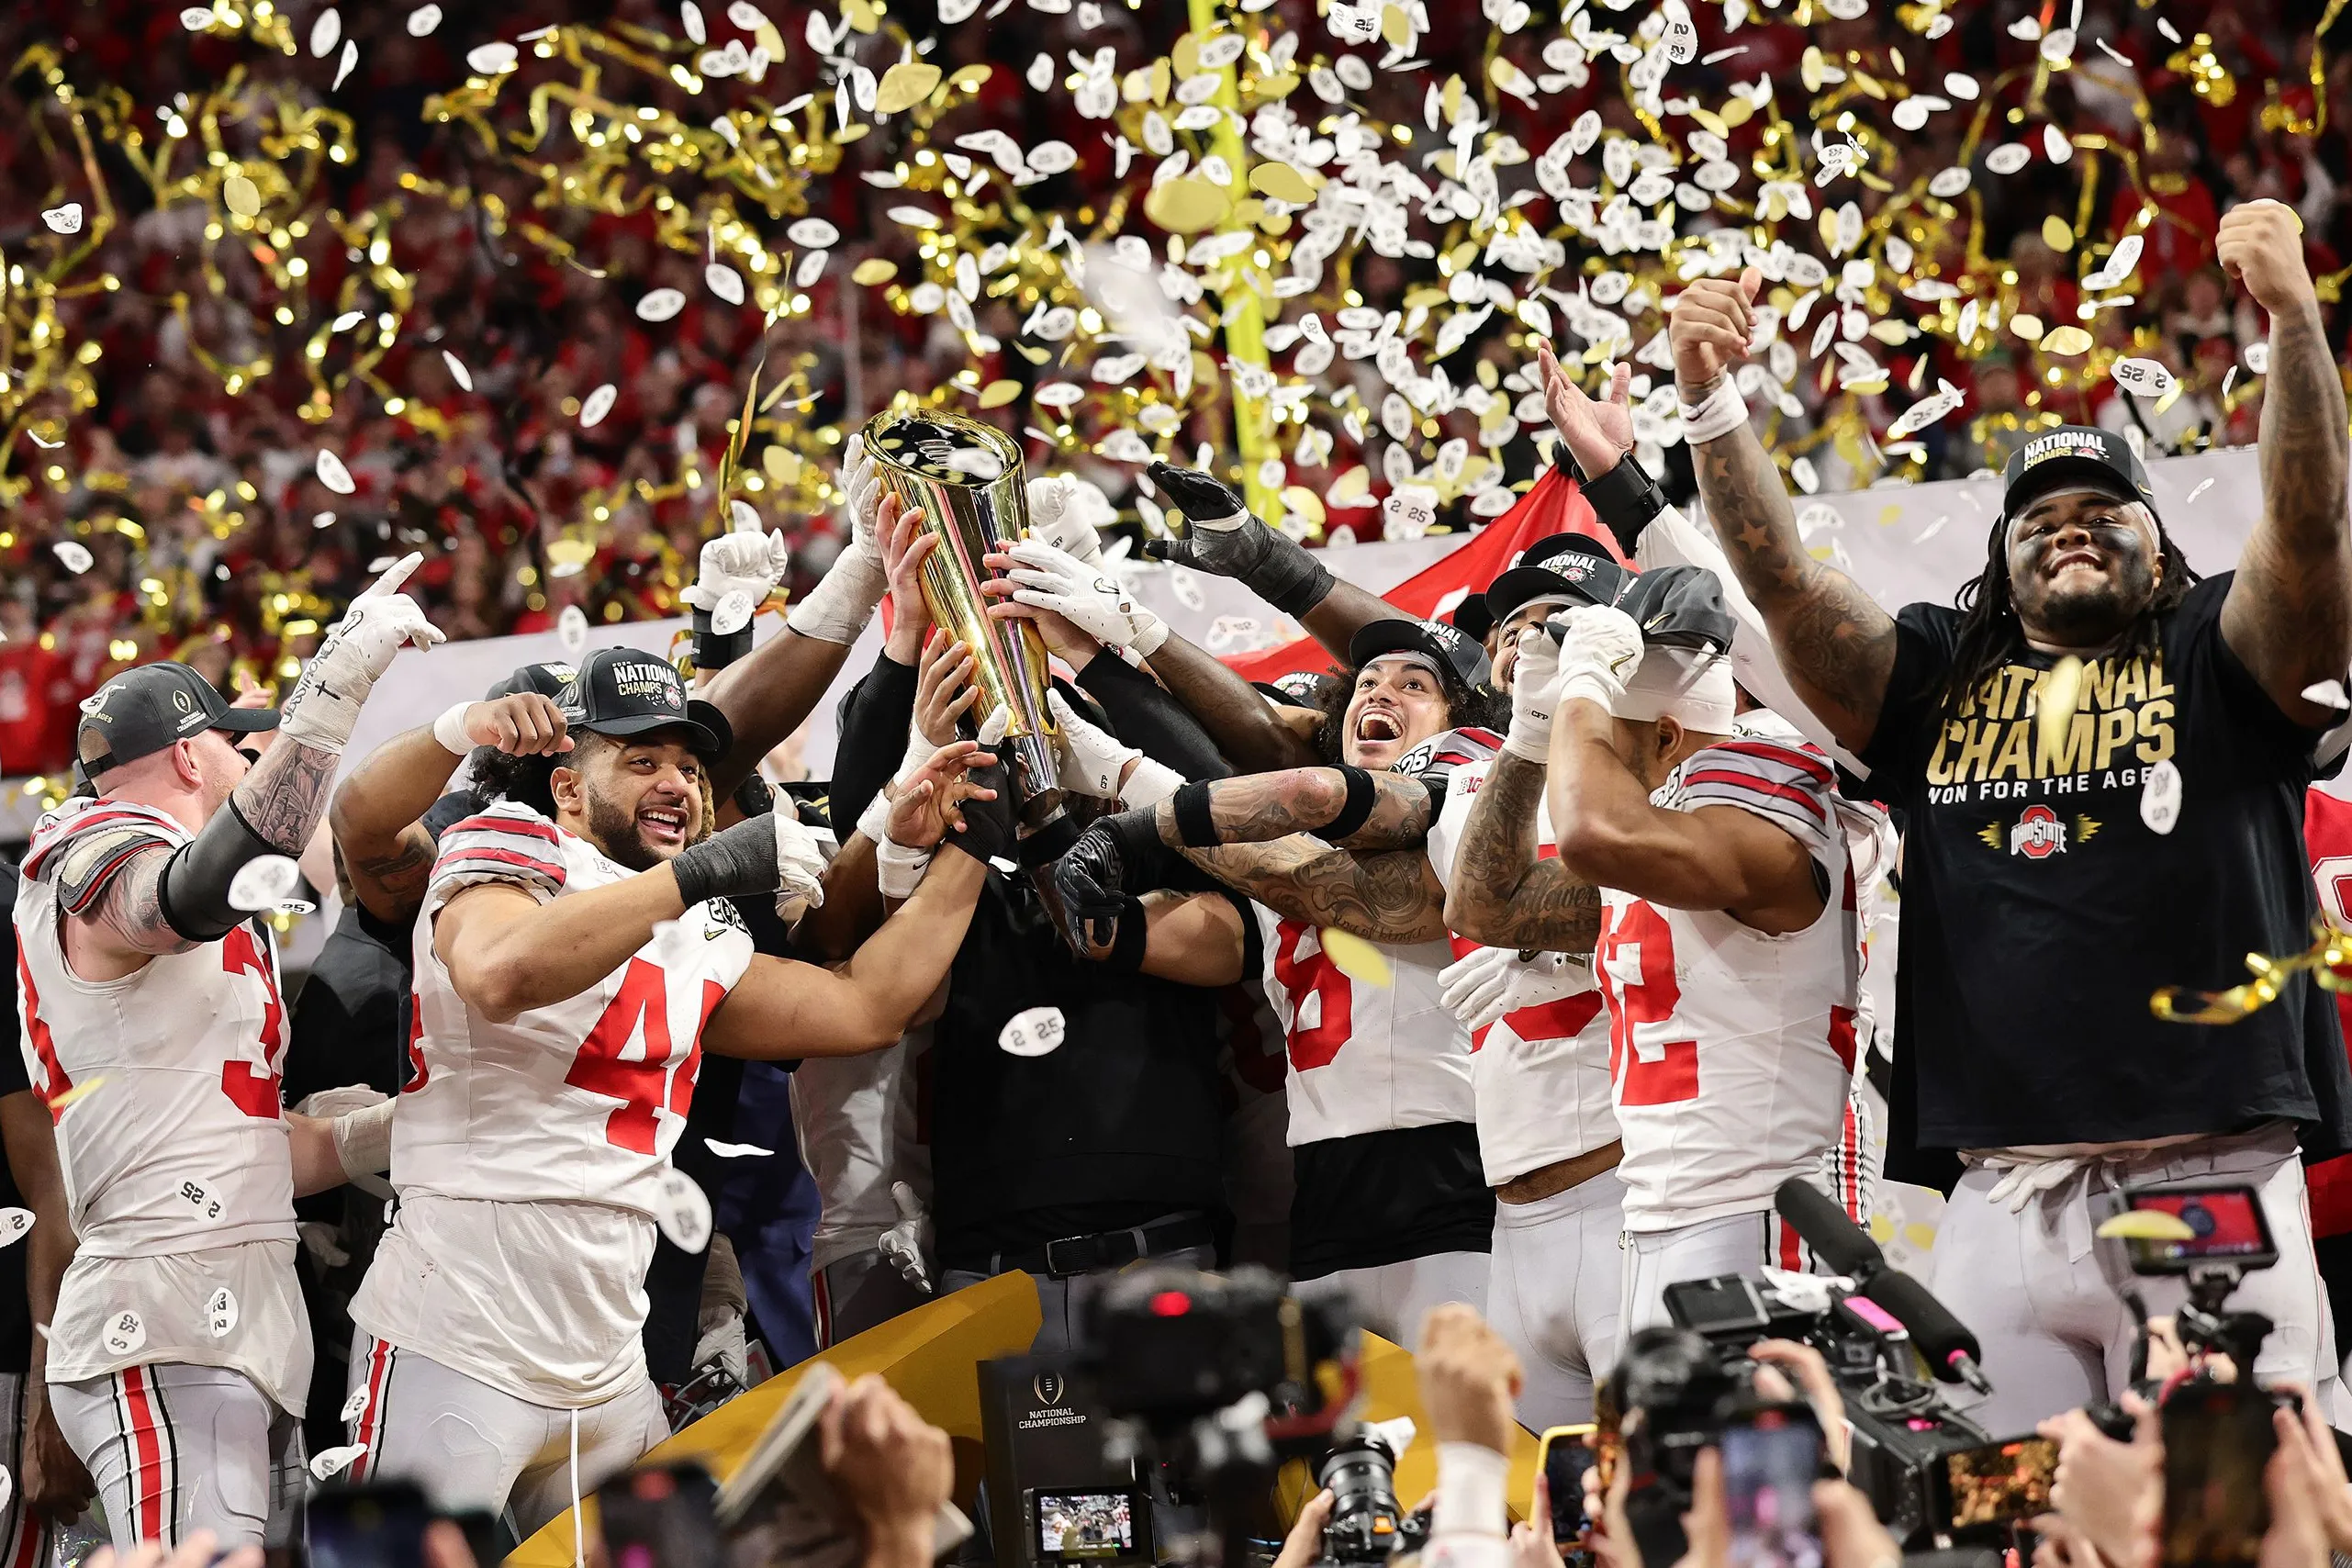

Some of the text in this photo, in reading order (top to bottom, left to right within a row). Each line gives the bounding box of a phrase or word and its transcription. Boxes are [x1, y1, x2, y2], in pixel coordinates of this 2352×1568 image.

[2024, 431, 2106, 462] NATIONAL
[1051, 535, 1063, 548] CFP
[612, 663, 681, 689] NATIONAL
[617, 682, 663, 697] CHAMPS
[1531, 711, 1549, 721] CFP
[1926, 699, 2176, 786] CHAMPS
[1978, 780, 2029, 801] FOR
[2041, 773, 2090, 796] THE
[2101, 766, 2161, 790] AGE
[1029, 1407, 1075, 1419] NATIONAL
[1018, 1415, 1087, 1429] CHAMPIONSHIP
